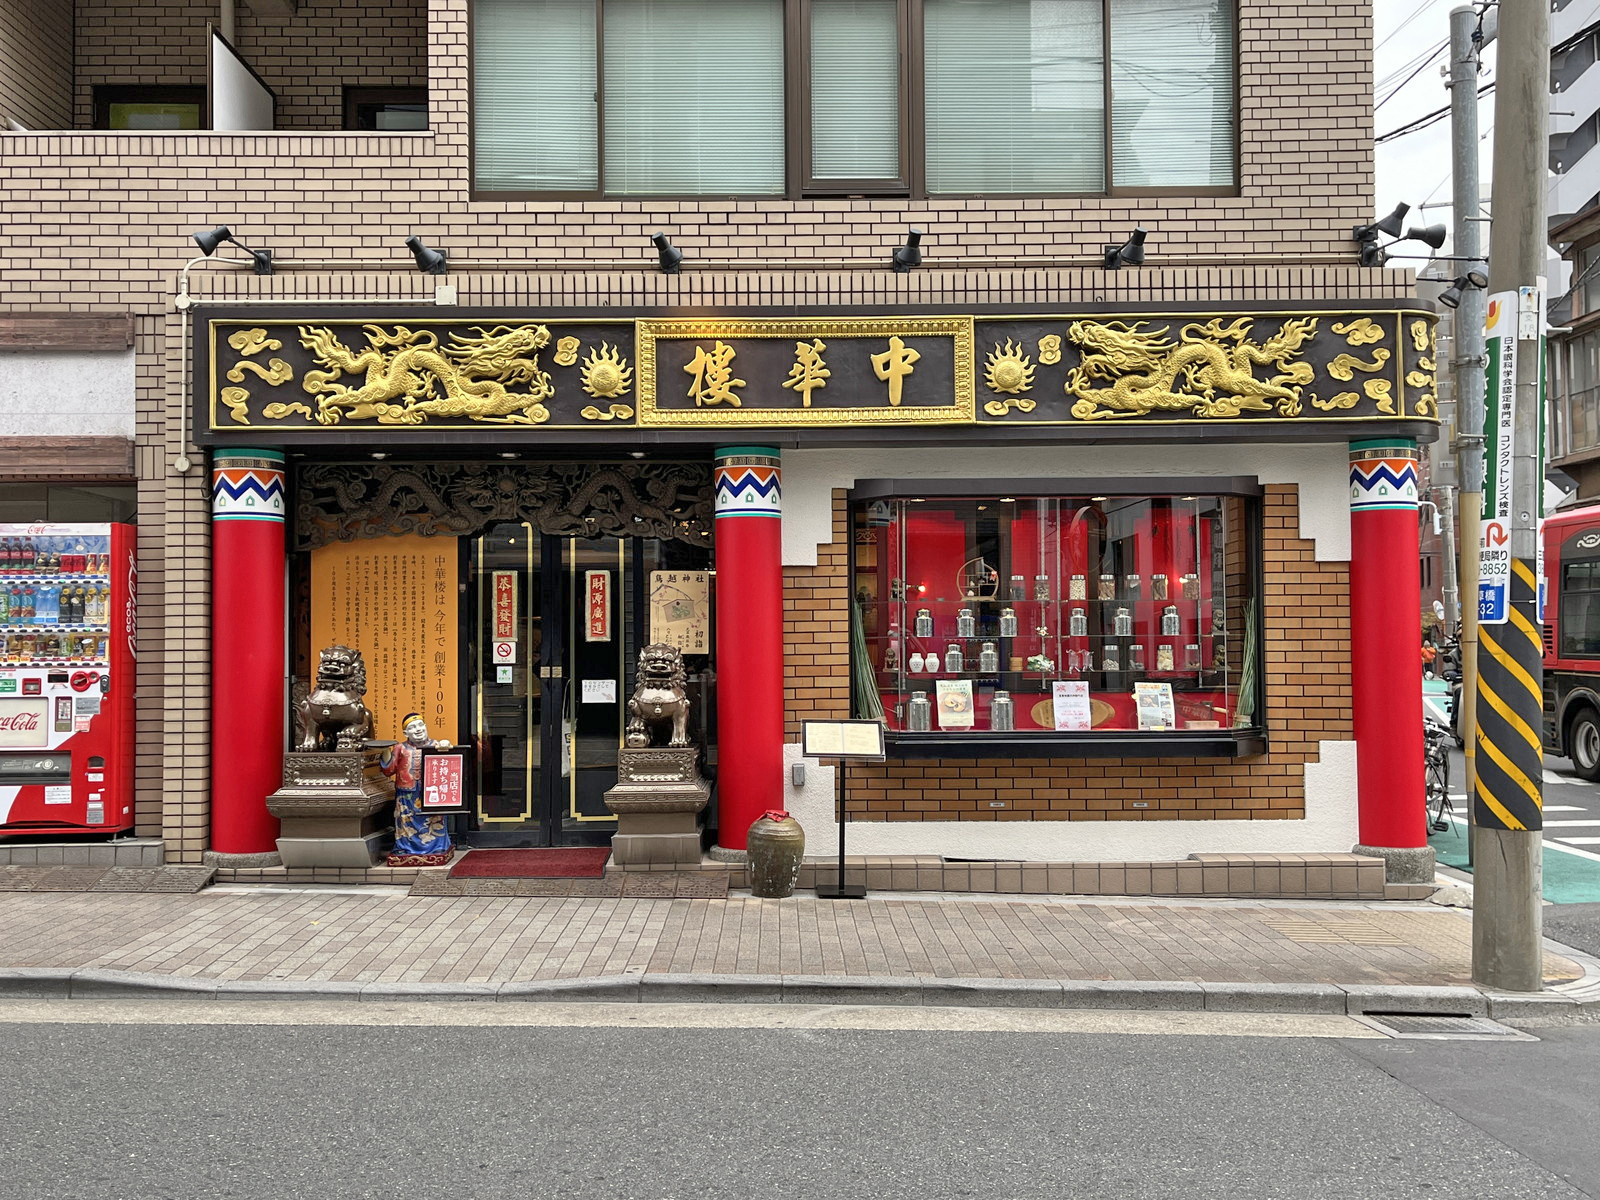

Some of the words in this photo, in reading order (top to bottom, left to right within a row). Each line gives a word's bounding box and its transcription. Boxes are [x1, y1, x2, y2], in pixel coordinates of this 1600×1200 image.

[1501, 336, 1514, 428] 日本眼科学会認定専門医
[1499, 435, 1510, 517] コンタクトレンズ検査
[498, 576, 512, 636] 恭喜發財
[591, 576, 605, 635] 財源廣進
[439, 758, 449, 802] お持ち帰り
